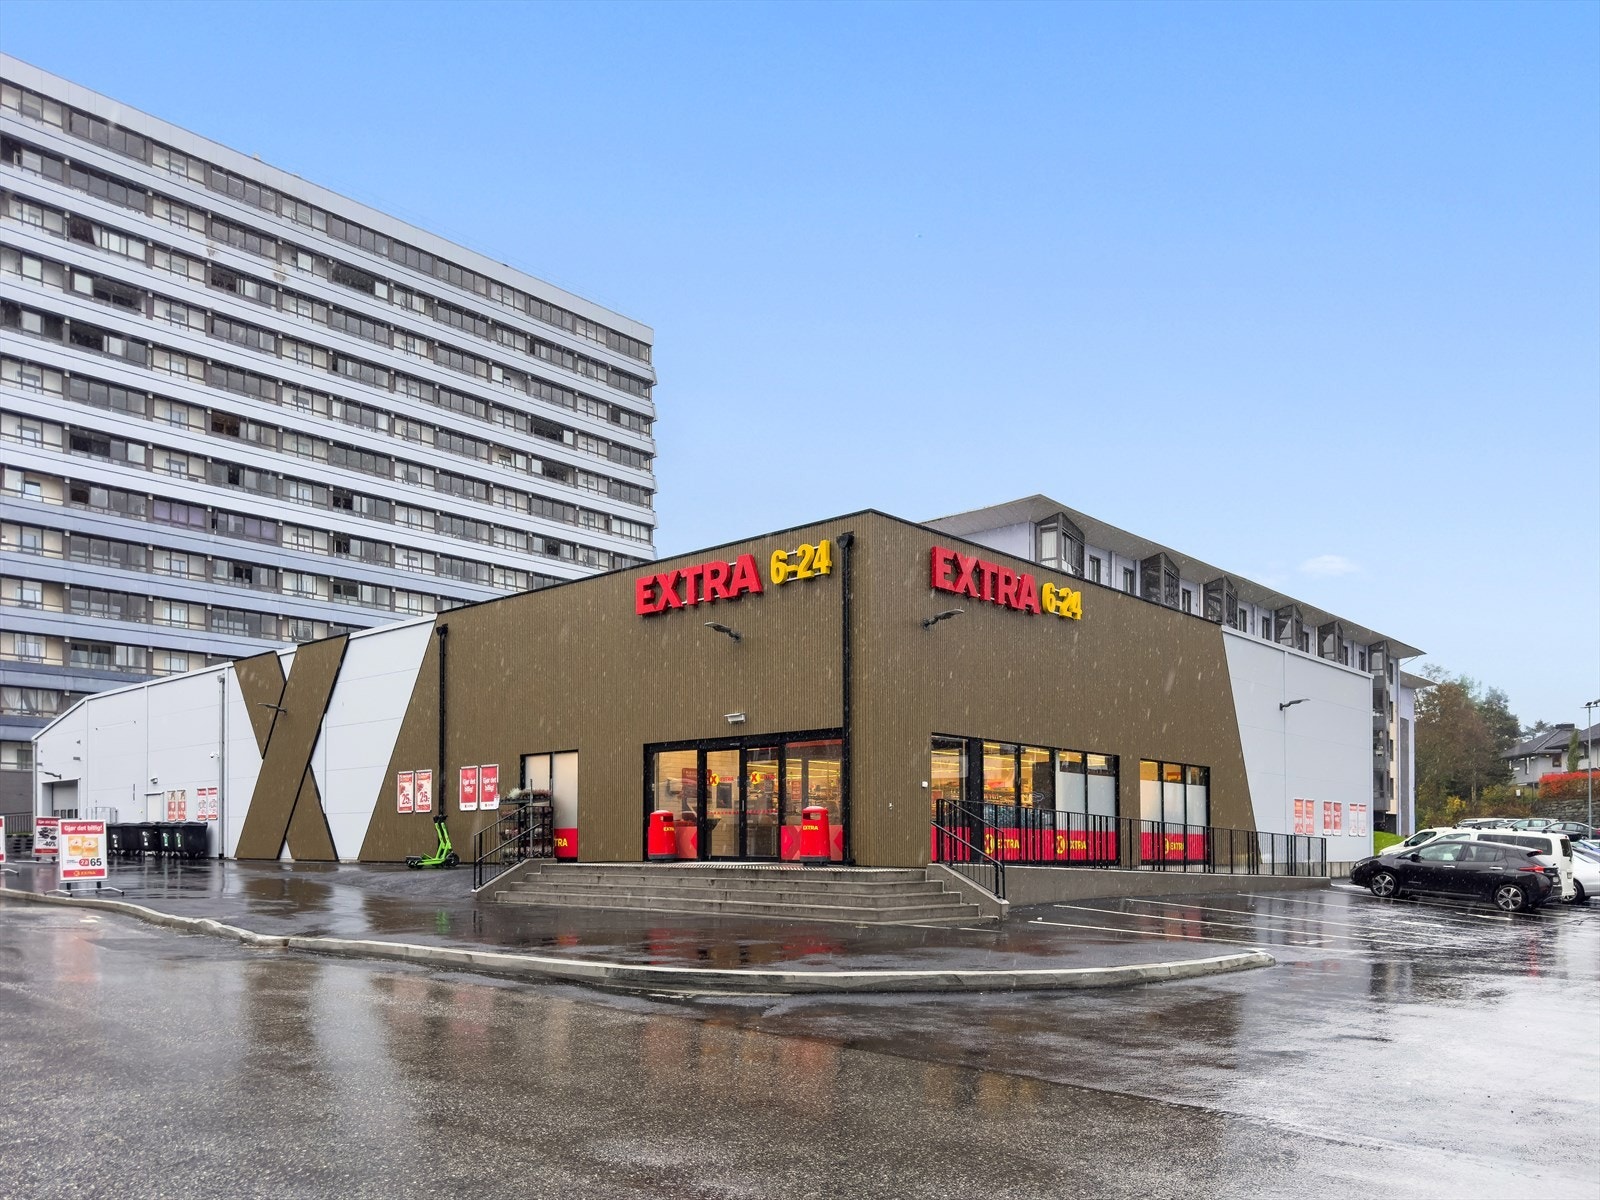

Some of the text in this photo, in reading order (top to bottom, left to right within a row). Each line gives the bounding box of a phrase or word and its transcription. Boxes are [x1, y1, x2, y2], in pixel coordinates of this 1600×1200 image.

[635, 540, 832, 614] EXTRA 6-24
[931, 546, 1082, 620] EXTRA 6-24
[90, 858, 102, 866] 65
